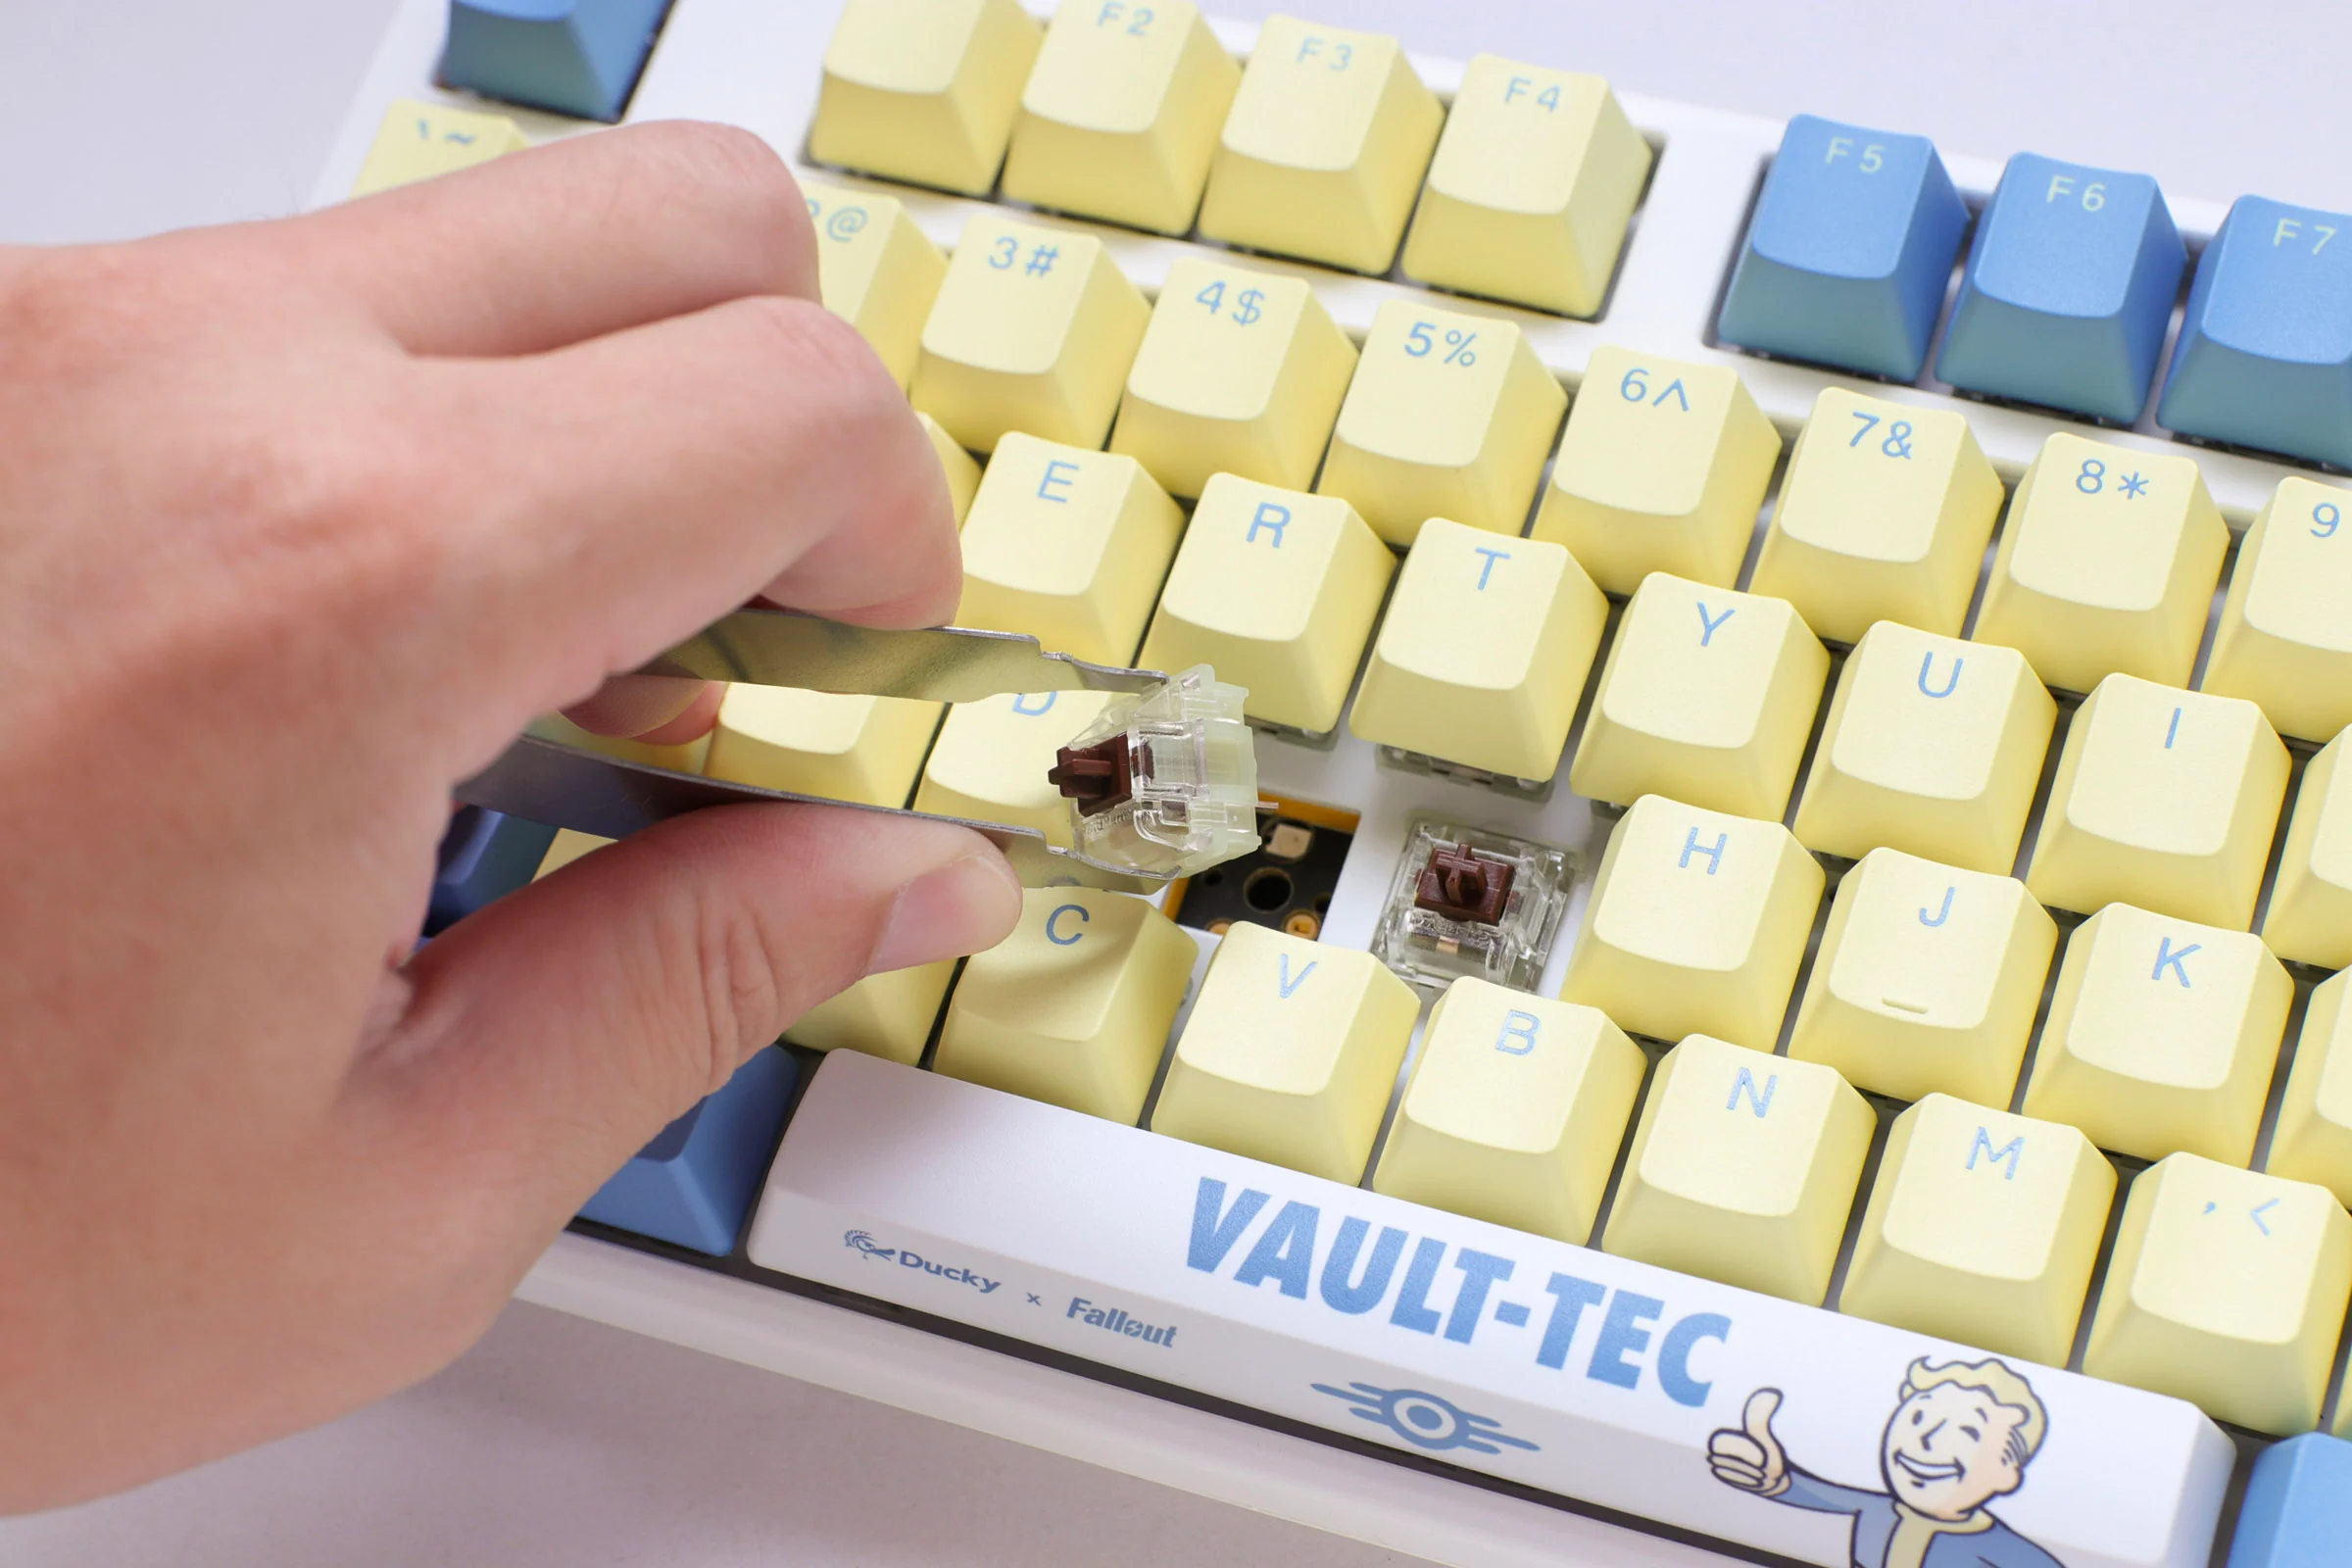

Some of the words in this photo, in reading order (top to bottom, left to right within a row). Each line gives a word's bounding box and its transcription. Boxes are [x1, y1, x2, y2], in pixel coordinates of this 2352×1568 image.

[1097, 0, 1155, 37] F2
[1296, 36, 1353, 73] F3
[1504, 76, 1562, 113] F4
[1826, 137, 1886, 173] F5
[2045, 175, 2107, 213] F6
[2272, 218, 2338, 256] F7
[1195, 280, 1267, 326] 4$
[1403, 320, 1478, 368] 5%
[1848, 412, 1913, 461] 7&
[1037, 460, 1080, 504] E
[1246, 501, 1292, 549] R
[2310, 502, 2341, 538] 9
[1475, 547, 1511, 591] T
[1695, 601, 1736, 647] Y
[1918, 651, 1964, 699] U
[2164, 707, 2182, 750] I
[1678, 826, 1728, 875] H
[1045, 904, 1090, 947] C
[1918, 886, 1957, 929] J
[1278, 952, 1318, 1000] V
[2151, 936, 2203, 989] K
[1494, 1009, 1542, 1057] B
[1726, 1066, 1779, 1119] N
[1965, 1125, 2026, 1181] M
[898, 1250, 1002, 1295] Ducky
[1065, 1297, 1178, 1349] Fallout
[1186, 1176, 1734, 1408] VAULT-TEC
